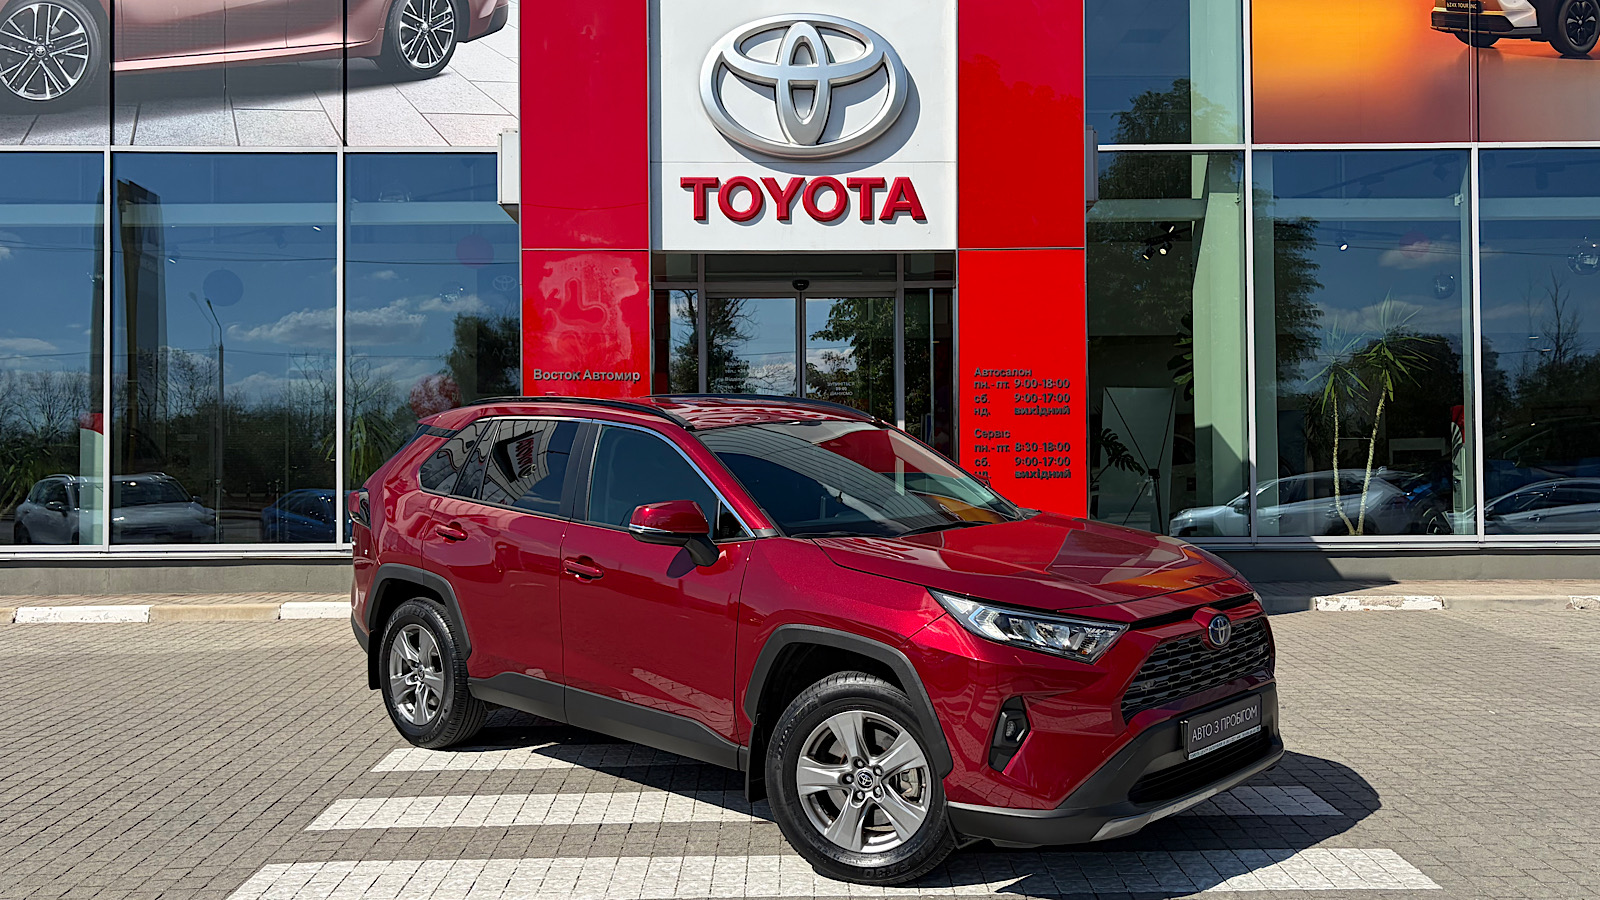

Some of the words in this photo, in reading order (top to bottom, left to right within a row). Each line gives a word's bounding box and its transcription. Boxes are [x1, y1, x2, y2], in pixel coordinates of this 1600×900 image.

[680, 176, 927, 221] TOYOTA
[533, 368, 581, 381] Восток
[582, 369, 641, 384] Автомир
[974, 367, 1032, 377] Автосалон
[1014, 379, 1070, 389] 9:00-18:00
[974, 393, 990, 403] сб.
[1014, 393, 1070, 403] 9:00-17:00
[974, 407, 991, 417] нд.
[1014, 405, 1071, 417] вихідний
[974, 428, 1011, 440] Сервіс
[1014, 442, 1071, 452] 8:30-18:00
[974, 456, 991, 467] сб.
[1014, 456, 1071, 467] 9:00-17:00
[1014, 468, 1071, 479] вихідний
[1192, 723, 1213, 742] АВТО
[1220, 705, 1258, 731] ПРОБІГОМ
